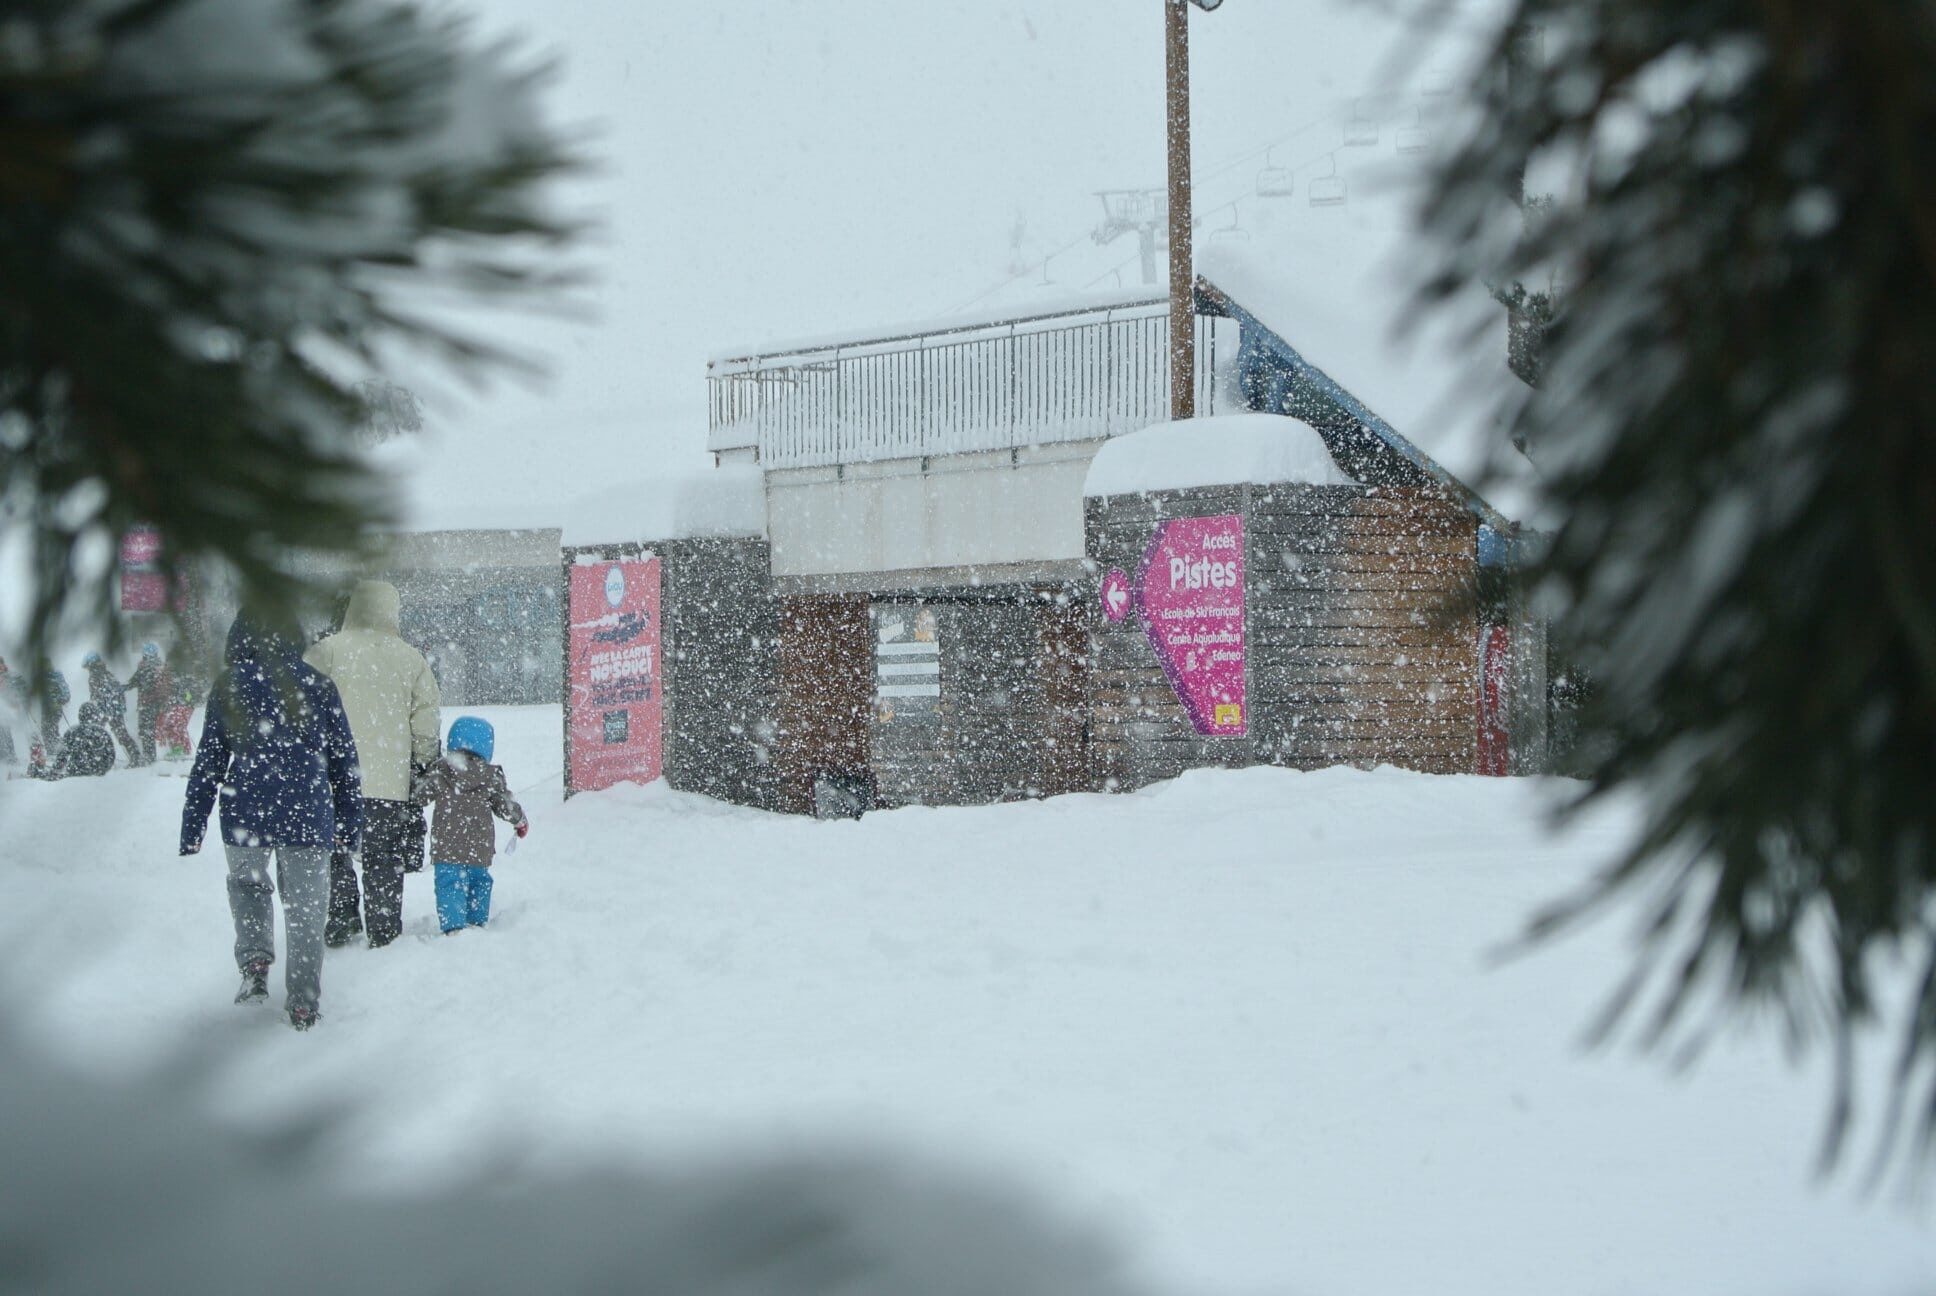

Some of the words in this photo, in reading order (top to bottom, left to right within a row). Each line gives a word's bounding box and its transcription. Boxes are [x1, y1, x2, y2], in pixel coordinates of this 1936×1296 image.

[1170, 554, 1237, 590] Pistes
[1196, 605, 1208, 618] Ski
[610, 650, 622, 662] LA
[622, 644, 652, 660] CARTE
